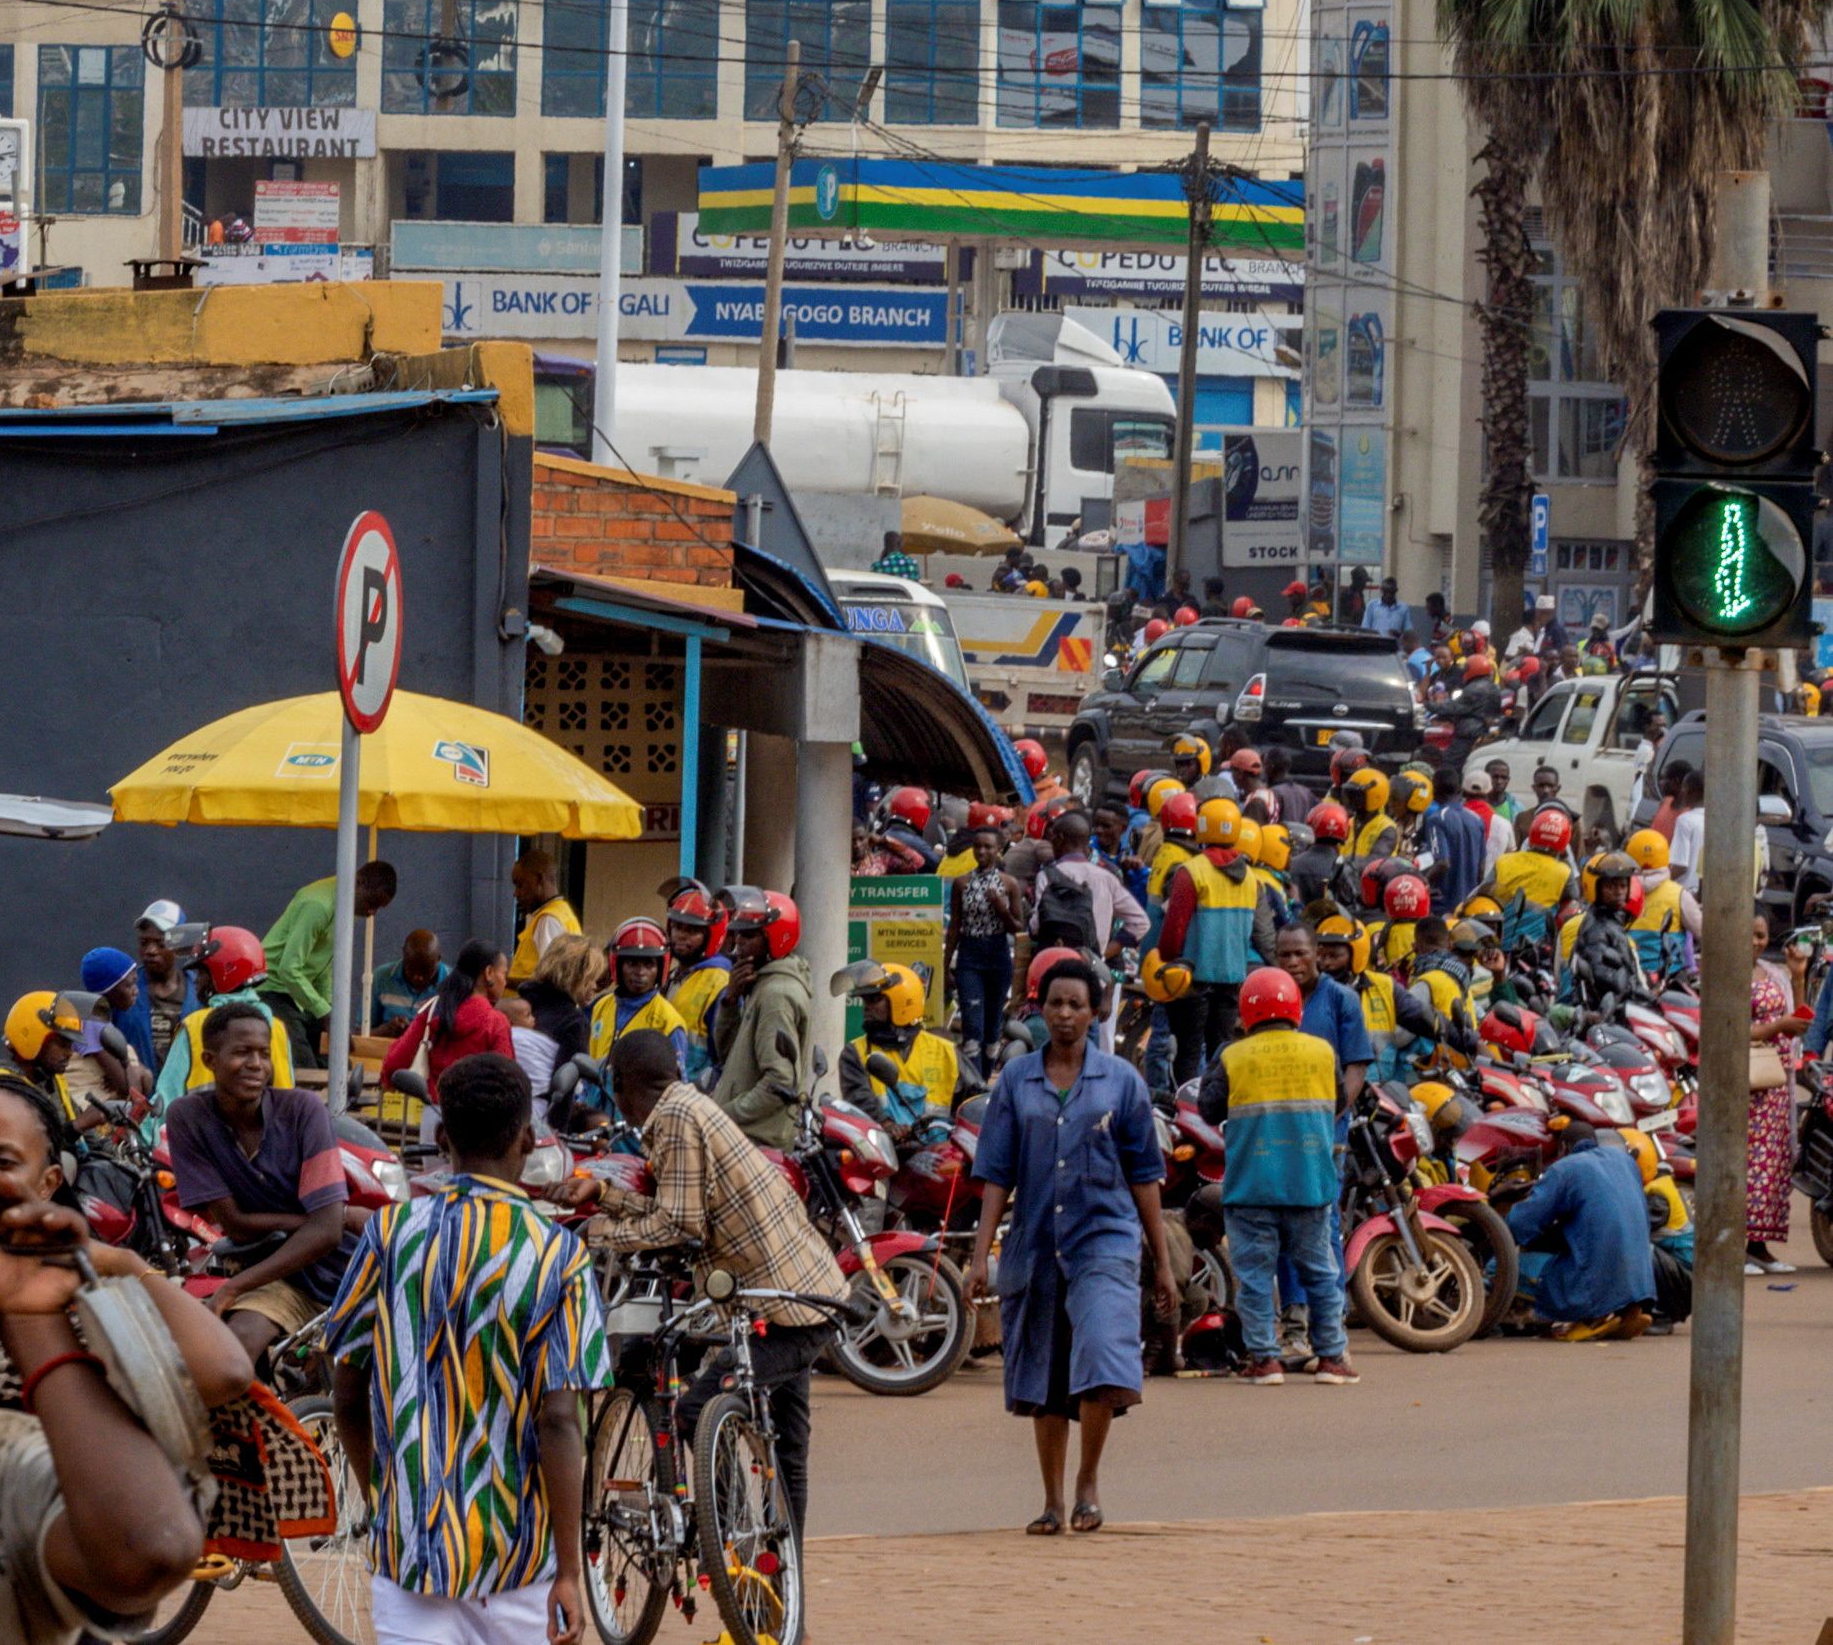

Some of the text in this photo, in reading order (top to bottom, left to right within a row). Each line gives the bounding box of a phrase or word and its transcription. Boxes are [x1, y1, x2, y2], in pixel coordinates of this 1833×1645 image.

[219, 108, 341, 131] CITY VIEW
[202, 137, 361, 158] RESTAURANT
[492, 290, 592, 315] BANK OF
[715, 300, 931, 327] NYABGOGO BRANCH
[1237, 328, 1268, 350] OF
[1535, 505, 1547, 542] P
[1248, 546, 1299, 559] STOCK
[356, 564, 389, 685] P
[295, 755, 328, 765] MTN
[860, 887, 930, 899] TRANSFER
[877, 928, 935, 938] MTN RWANDA
[885, 941, 927, 950] SERVICES
